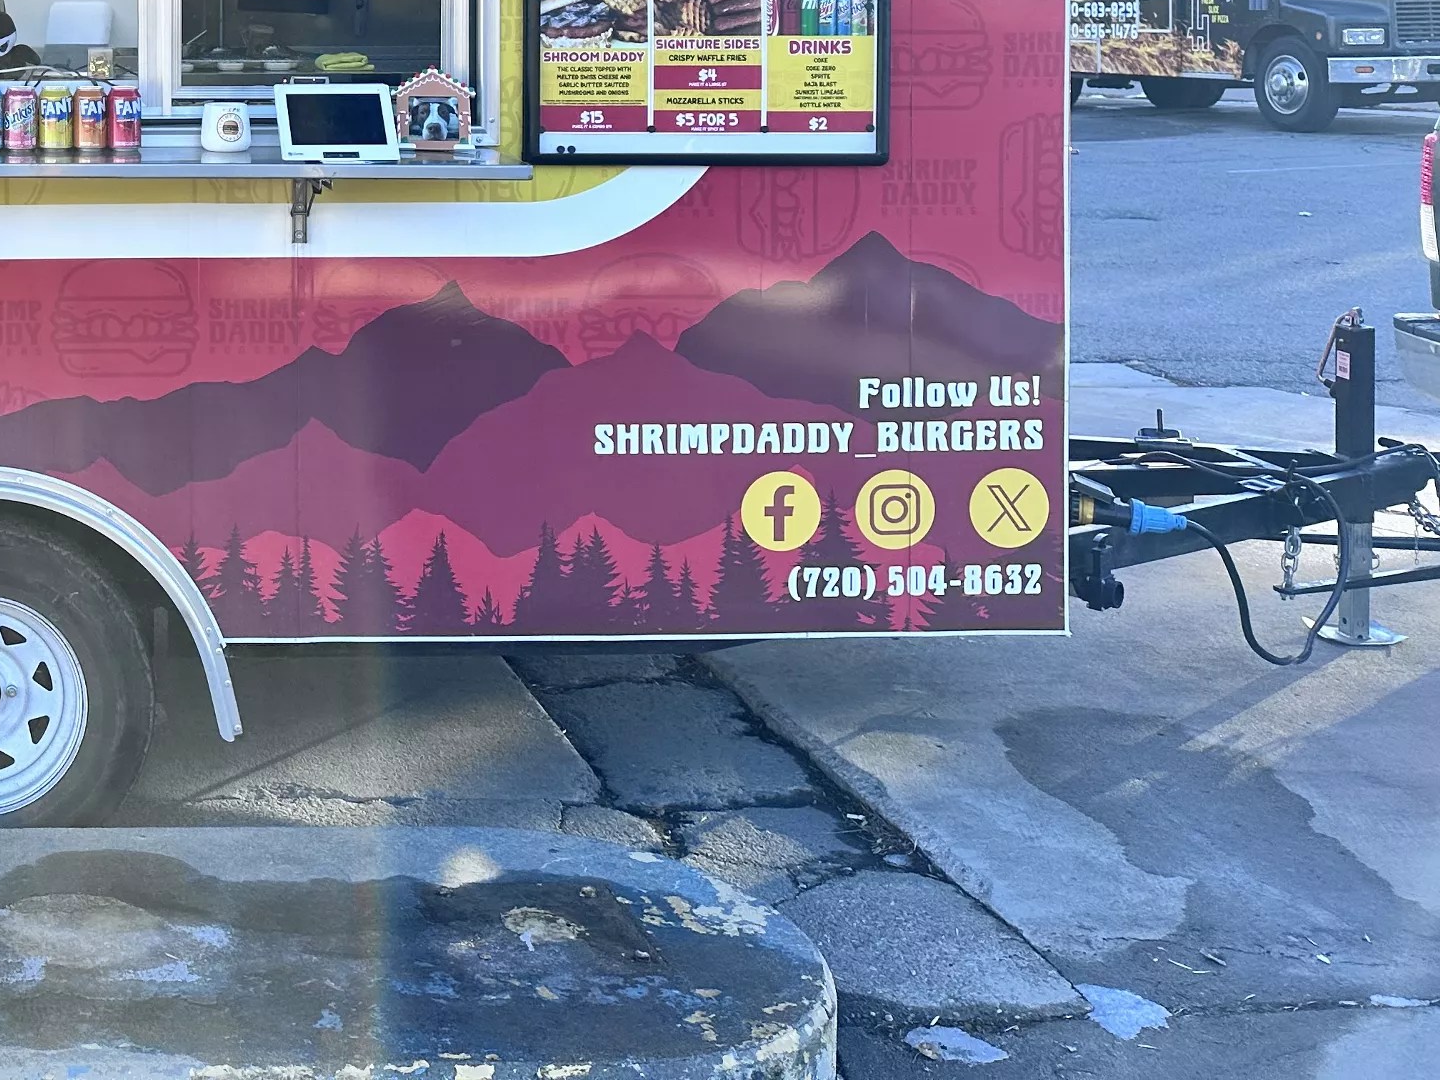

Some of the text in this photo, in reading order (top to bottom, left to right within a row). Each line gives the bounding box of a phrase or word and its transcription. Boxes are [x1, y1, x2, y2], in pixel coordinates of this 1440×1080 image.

[655, 38, 760, 50] SIGNITURE SIDES
[788, 40, 852, 55] DRINKS
[541, 51, 645, 63] SHROOM DADDY
[668, 54, 748, 62] CRISPY WAFFLE FRIES
[698, 68, 718, 82] $4
[666, 97, 745, 105] MOZZARELLA STICKS
[580, 110, 605, 125] $15
[675, 112, 739, 127] $5 FOR 5
[808, 116, 828, 131] $2
[858, 375, 1041, 409] Follow Us!
[593, 419, 1044, 458] SHRIMPDADDY_BURGERS
[786, 563, 1043, 602] (720) 504-8632
